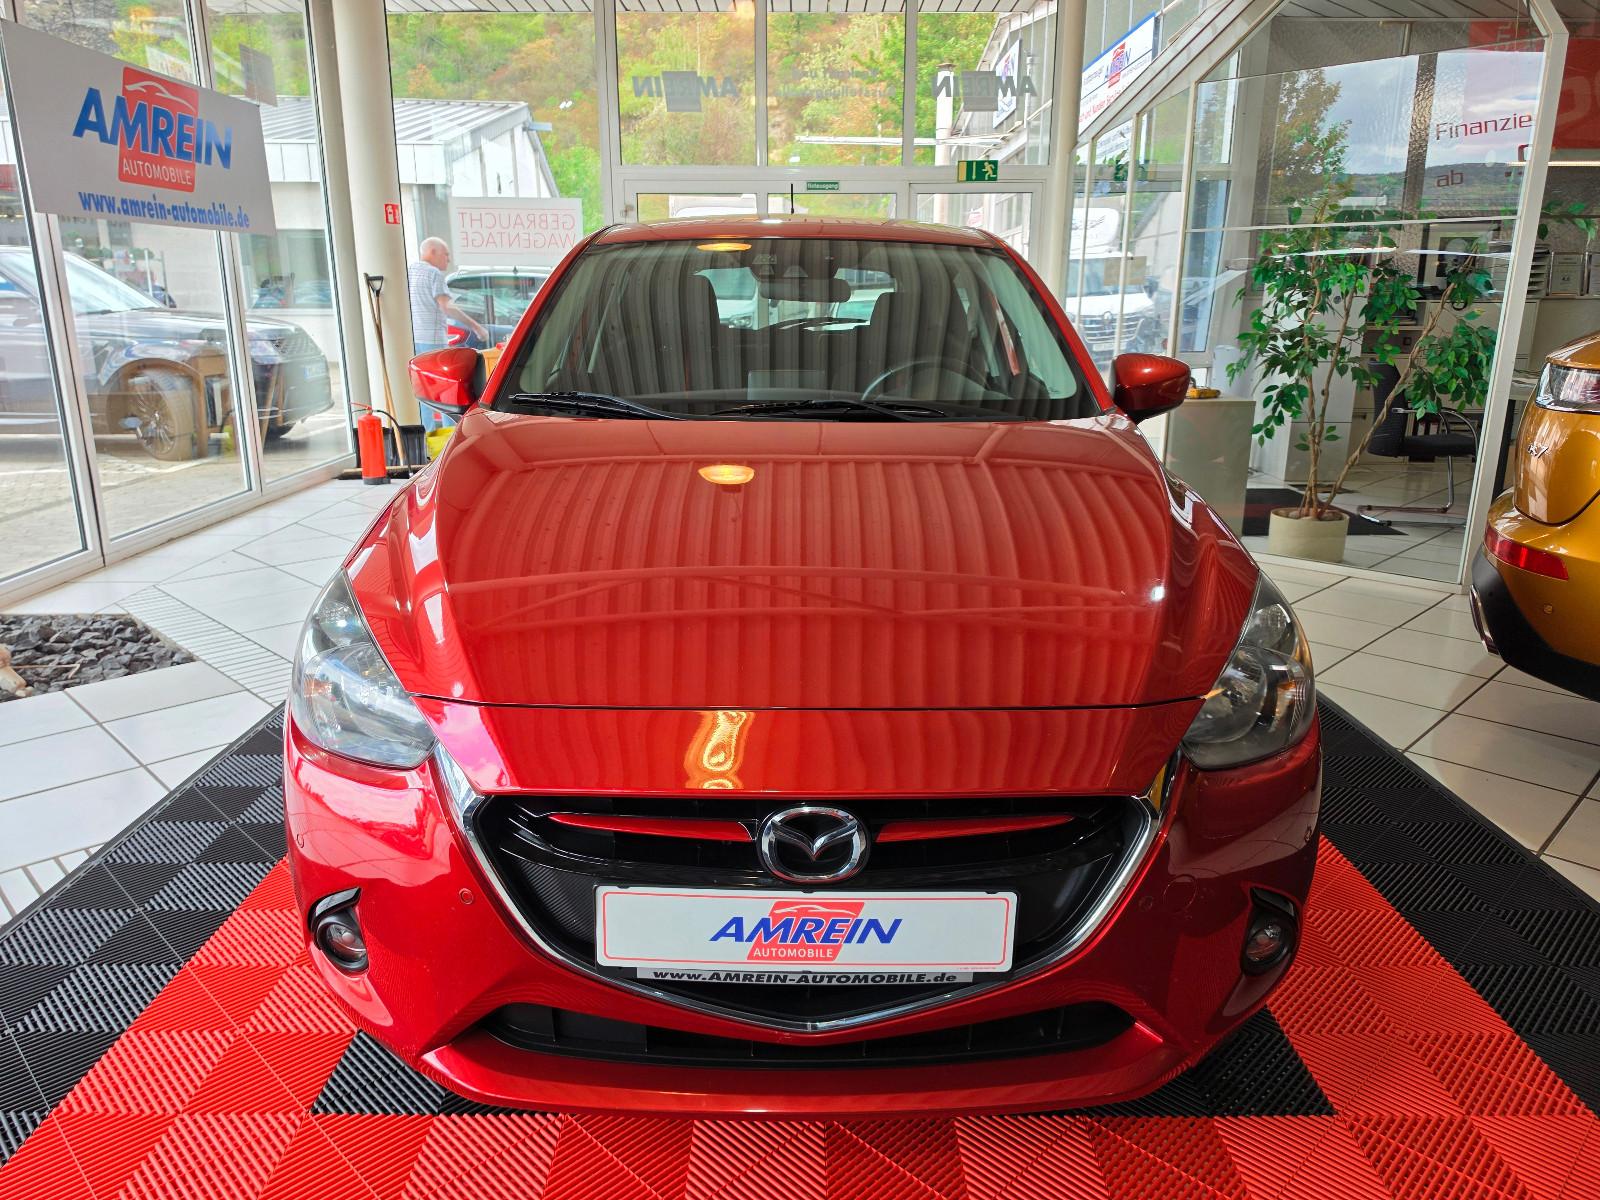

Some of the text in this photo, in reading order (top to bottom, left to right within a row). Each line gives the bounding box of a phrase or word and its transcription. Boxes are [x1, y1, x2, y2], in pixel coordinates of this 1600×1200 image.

[72, 87, 233, 169] AMREIN
[122, 158, 193, 186] AUTOMOBILE
[1436, 170, 1464, 187] ab
[78, 191, 250, 228] www.amrein-automobile.de
[709, 916, 903, 945] AMREIN
[752, 947, 834, 959] AUTOMOBILE
[652, 970, 958, 984] www.AMREIN-AUTOMOBILE.de
